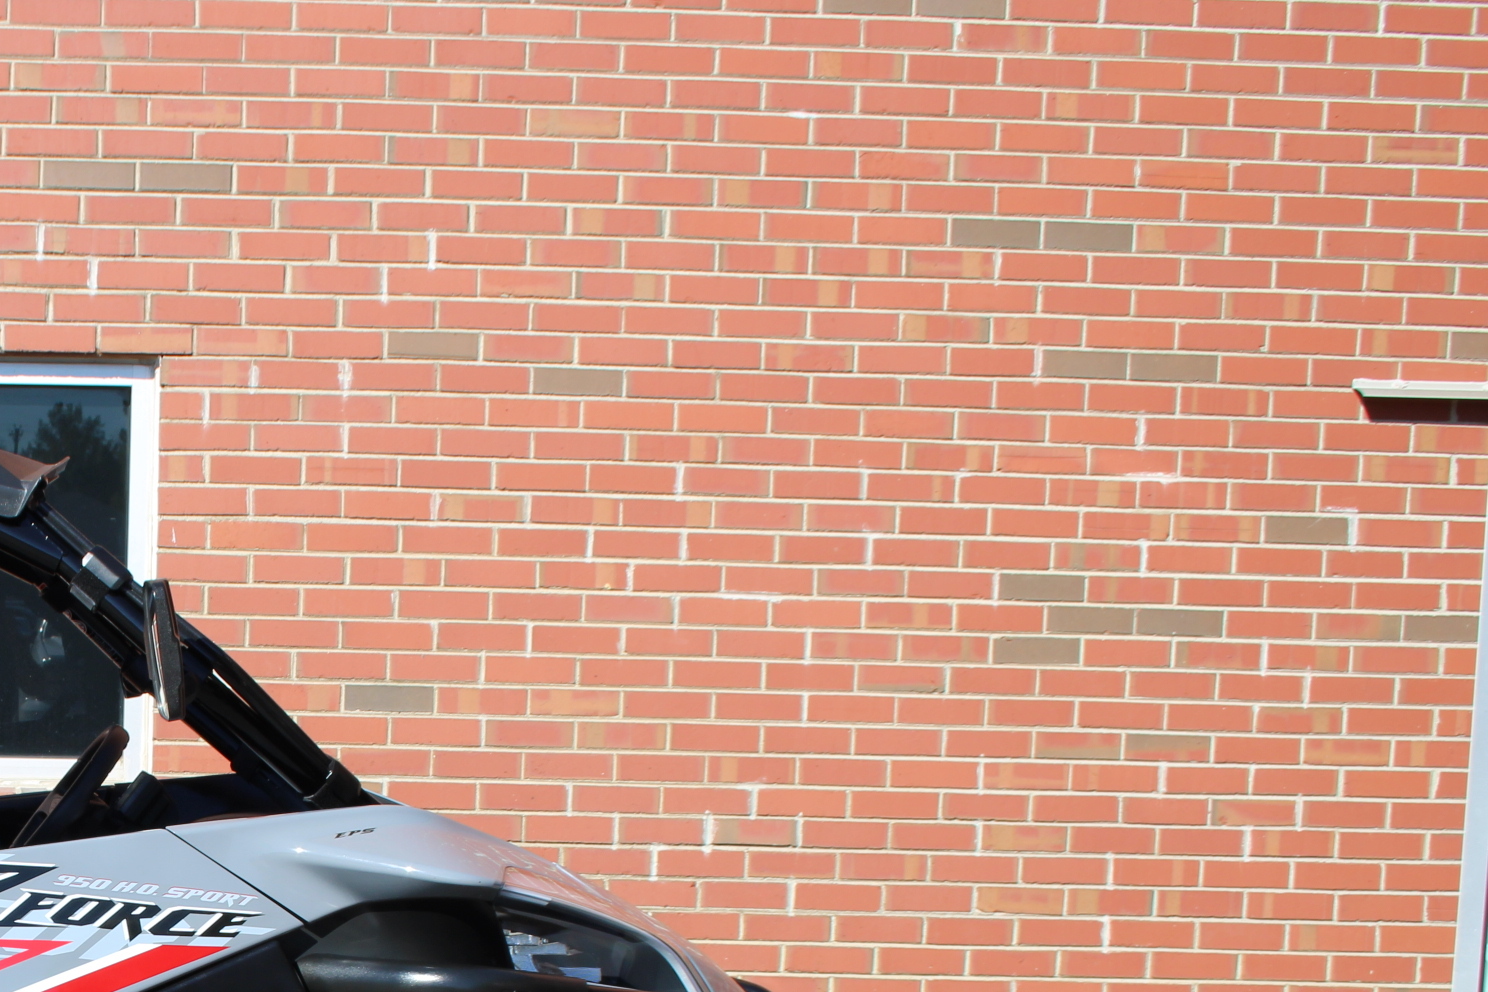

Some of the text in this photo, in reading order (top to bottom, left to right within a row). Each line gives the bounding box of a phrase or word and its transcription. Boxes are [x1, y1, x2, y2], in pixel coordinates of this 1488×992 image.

[334, 826, 377, 839] EPS
[53, 874, 259, 908] 950 H.O. SPORT
